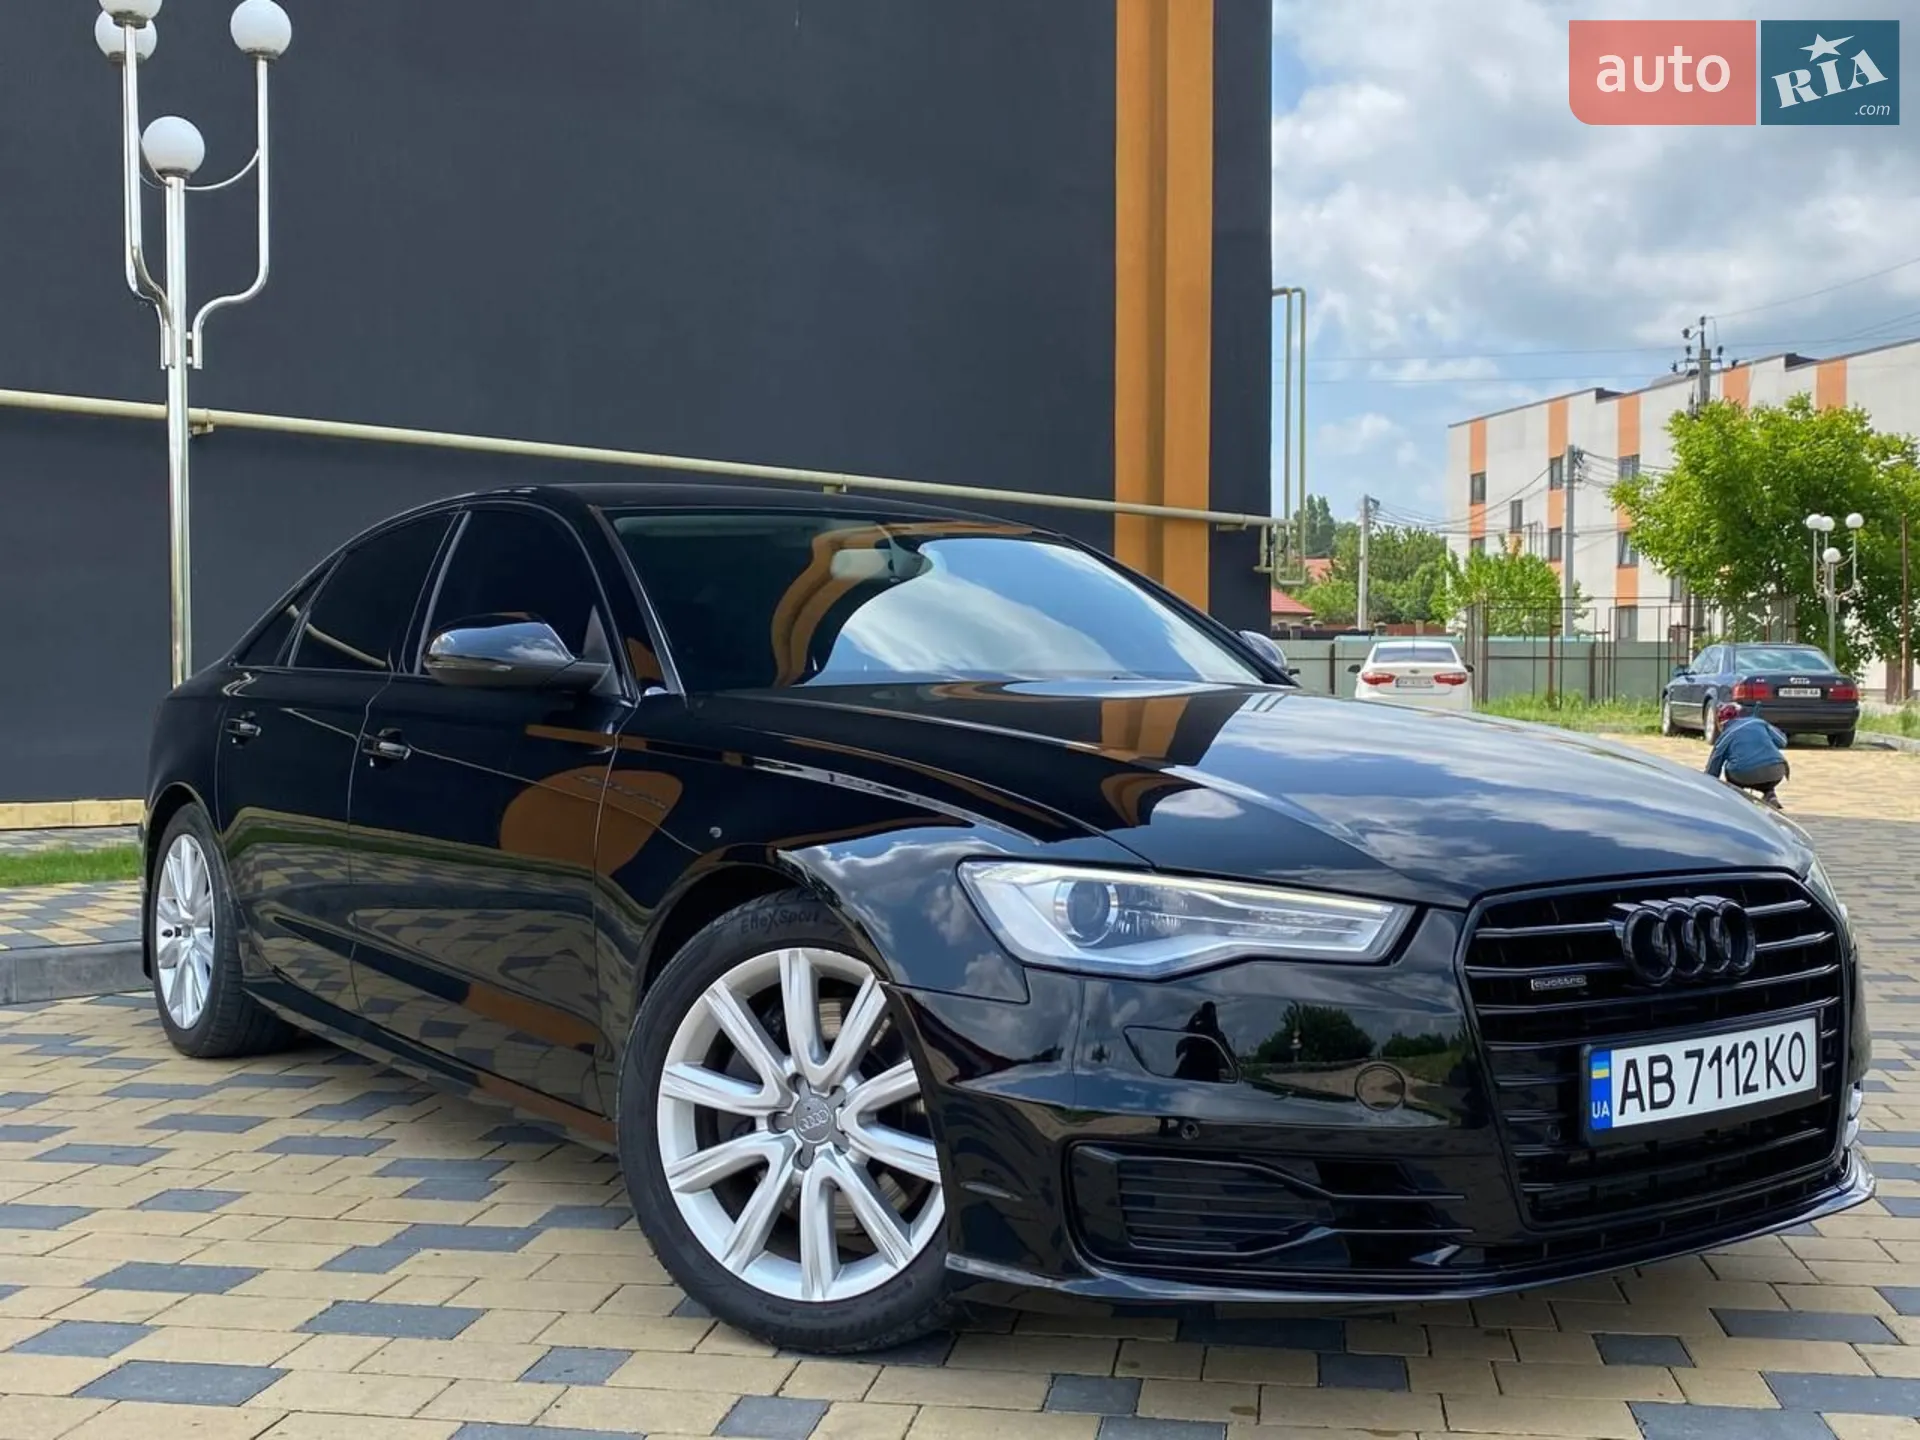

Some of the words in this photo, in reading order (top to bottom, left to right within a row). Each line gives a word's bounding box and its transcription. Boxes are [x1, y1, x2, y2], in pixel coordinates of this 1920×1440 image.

[1618, 1054, 1676, 1116] AB
[1684, 1040, 1759, 1105] 7112
[1592, 1101, 1610, 1118] UA
